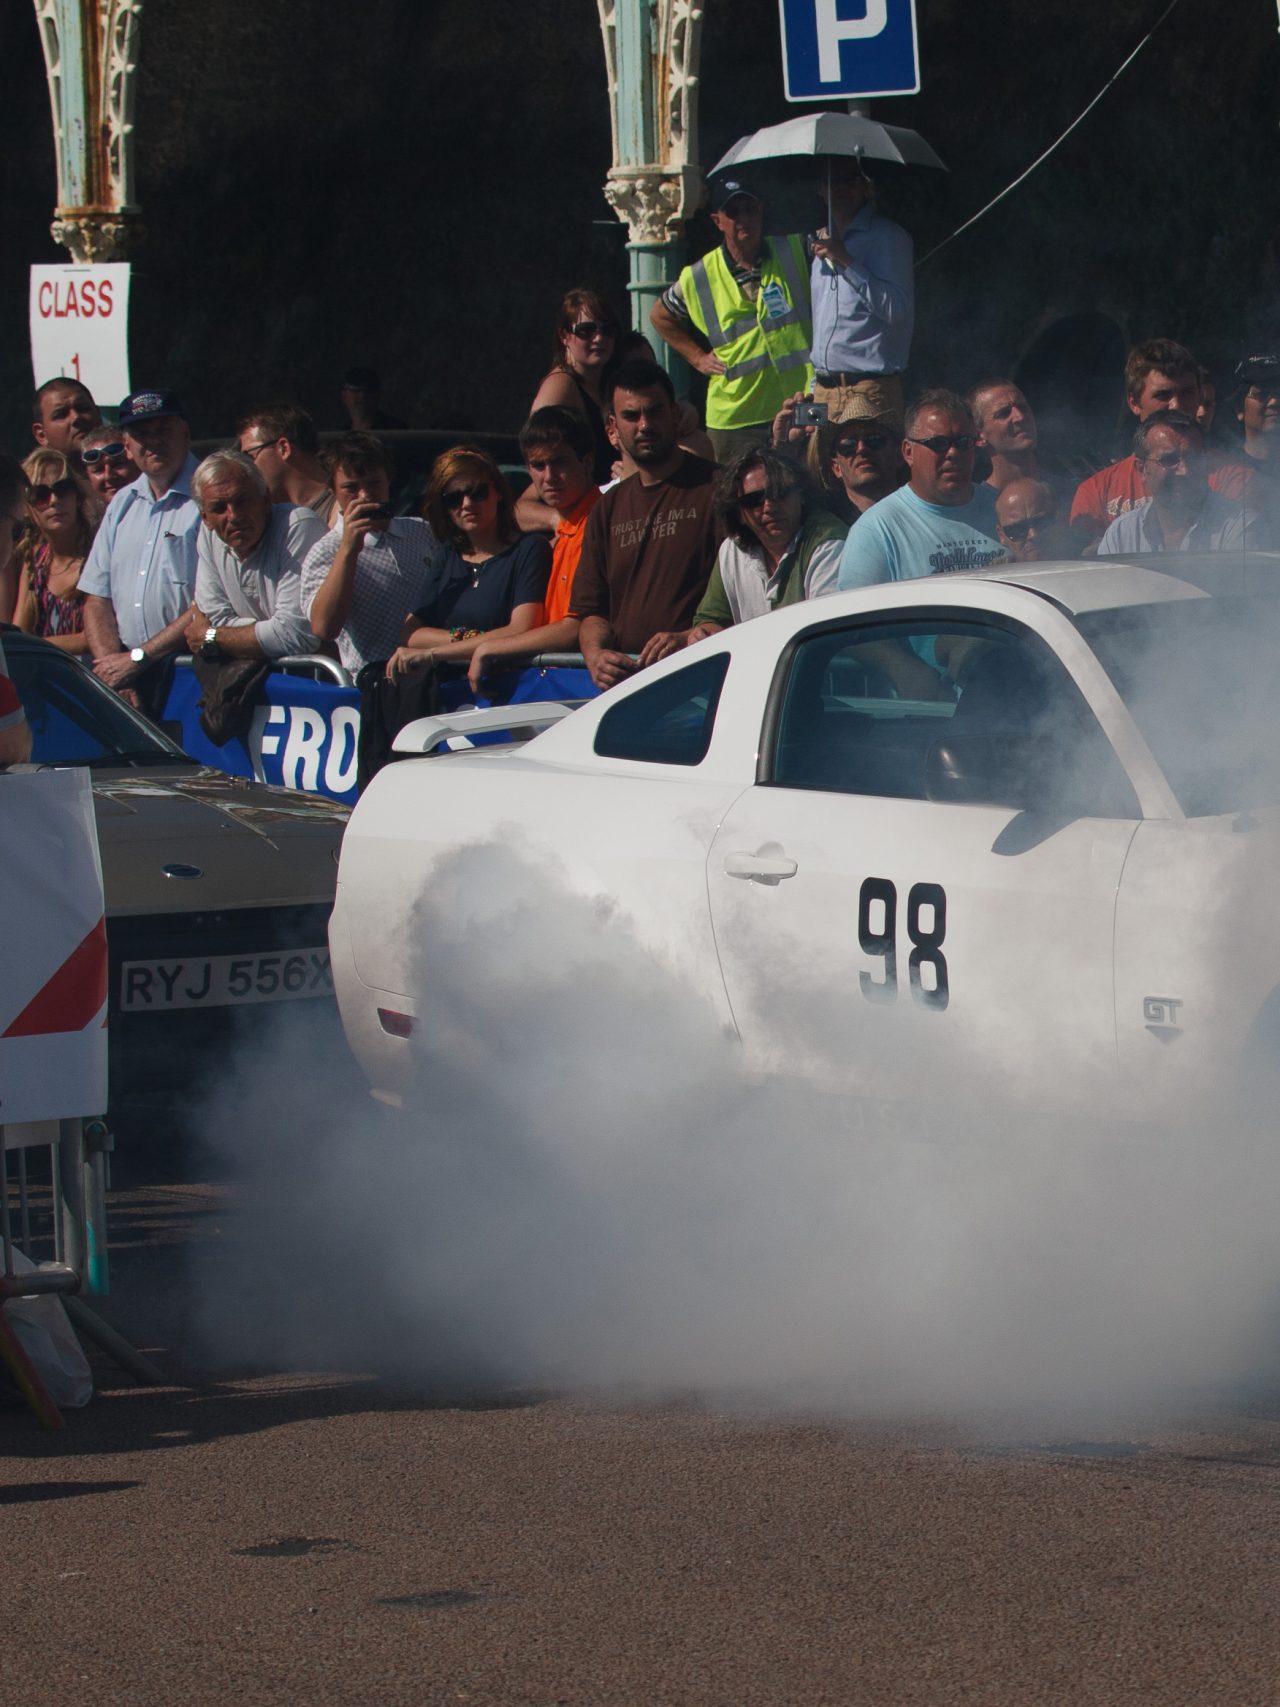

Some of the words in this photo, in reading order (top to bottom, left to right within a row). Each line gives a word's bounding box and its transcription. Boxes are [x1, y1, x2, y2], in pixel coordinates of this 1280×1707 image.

[815, 0, 888, 83] P
[38, 279, 113, 318] CLASS
[611, 518, 643, 537] TRUST
[687, 508, 697, 519] A
[620, 521, 678, 548] LAWYER
[858, 876, 950, 1013] 98
[126, 963, 212, 1005] RYJ
[227, 955, 334, 997] 556X
[1144, 996, 1184, 1024] GT
